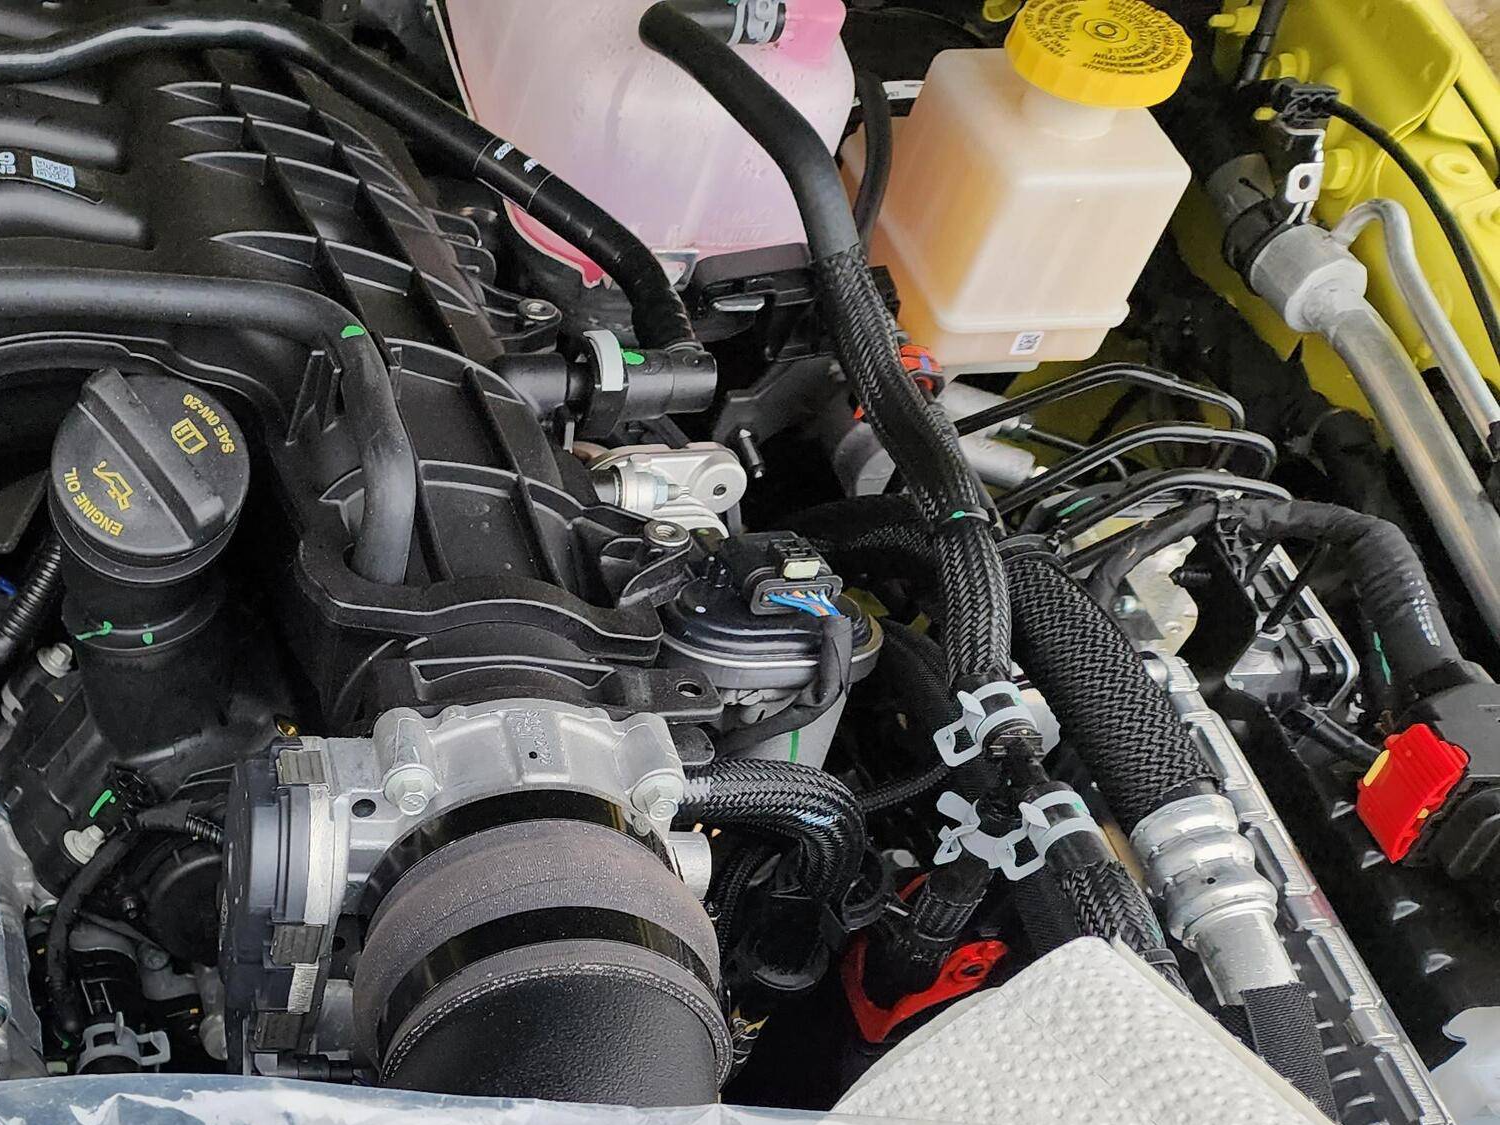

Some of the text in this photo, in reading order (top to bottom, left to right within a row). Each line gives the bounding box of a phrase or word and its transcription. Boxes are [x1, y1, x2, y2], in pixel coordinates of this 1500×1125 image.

[183, 393, 236, 454] SAE 0W-20
[63, 467, 124, 537] ENGINE OIL
